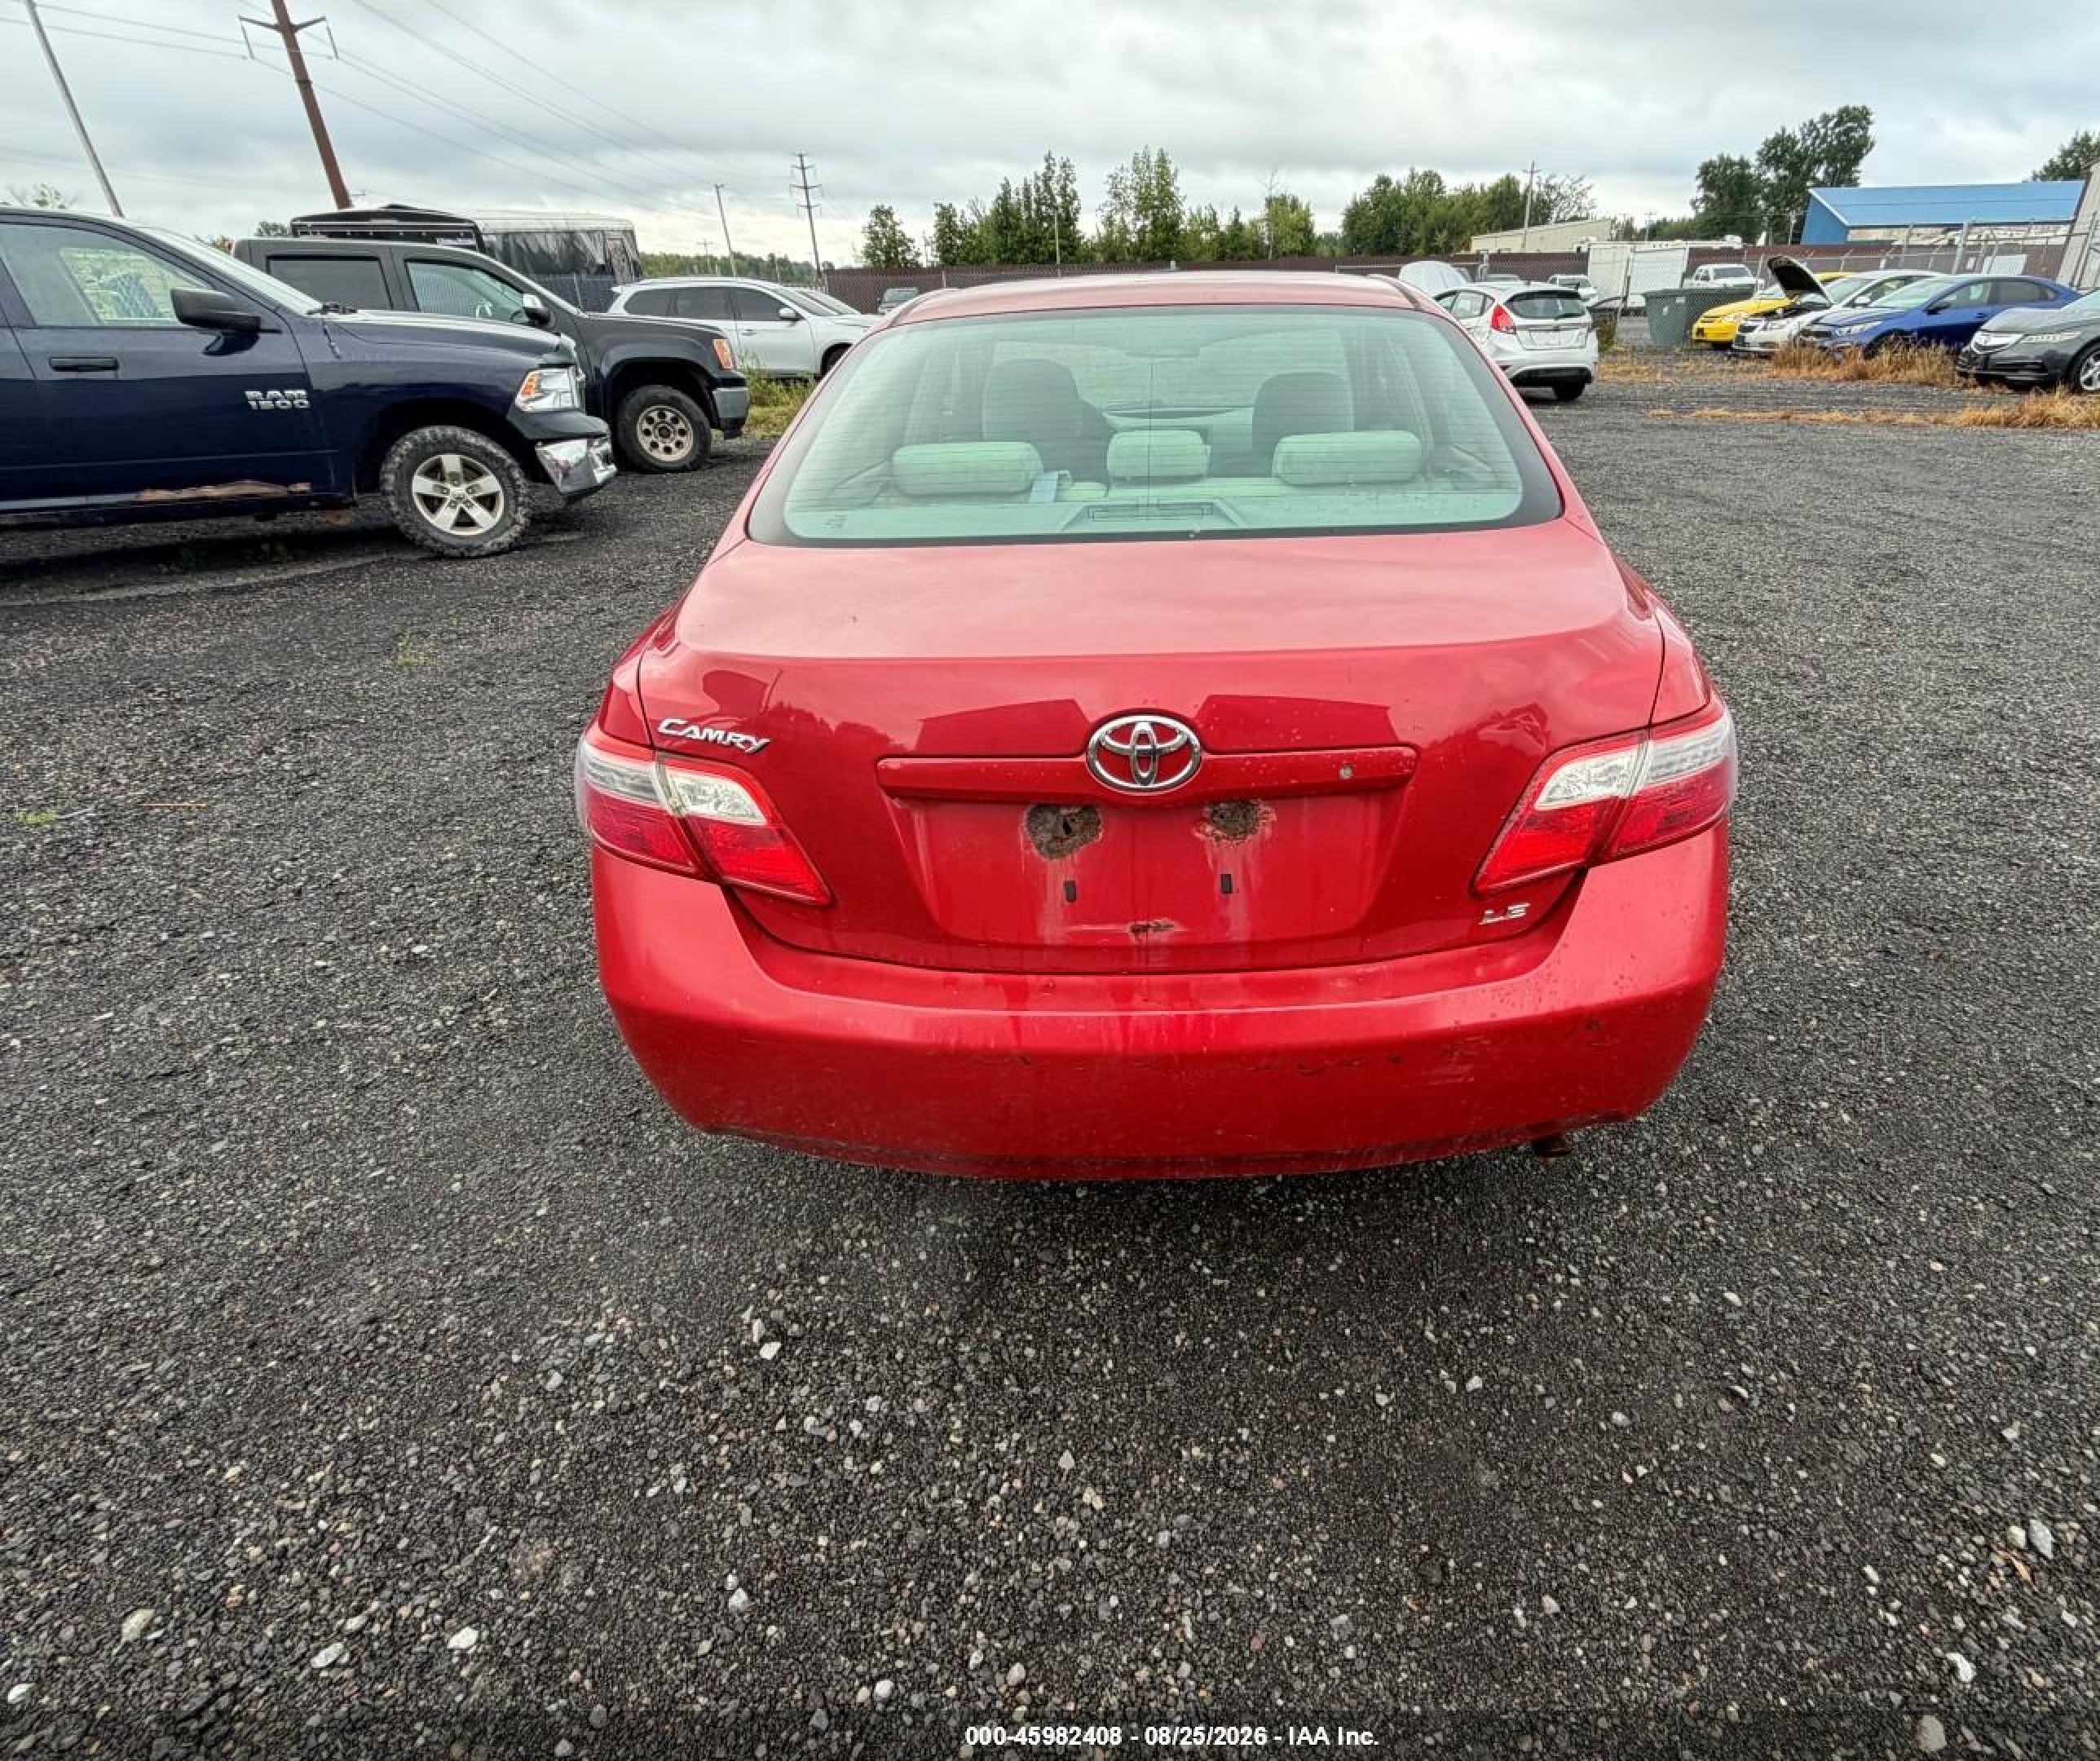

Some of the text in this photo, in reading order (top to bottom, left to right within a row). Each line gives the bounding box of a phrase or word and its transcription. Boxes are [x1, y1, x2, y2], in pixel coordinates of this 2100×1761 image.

[245, 390, 307, 400] RAM
[247, 399, 310, 409] 1500
[658, 718, 770, 753] CAMRY
[1478, 902, 1530, 925] LE
